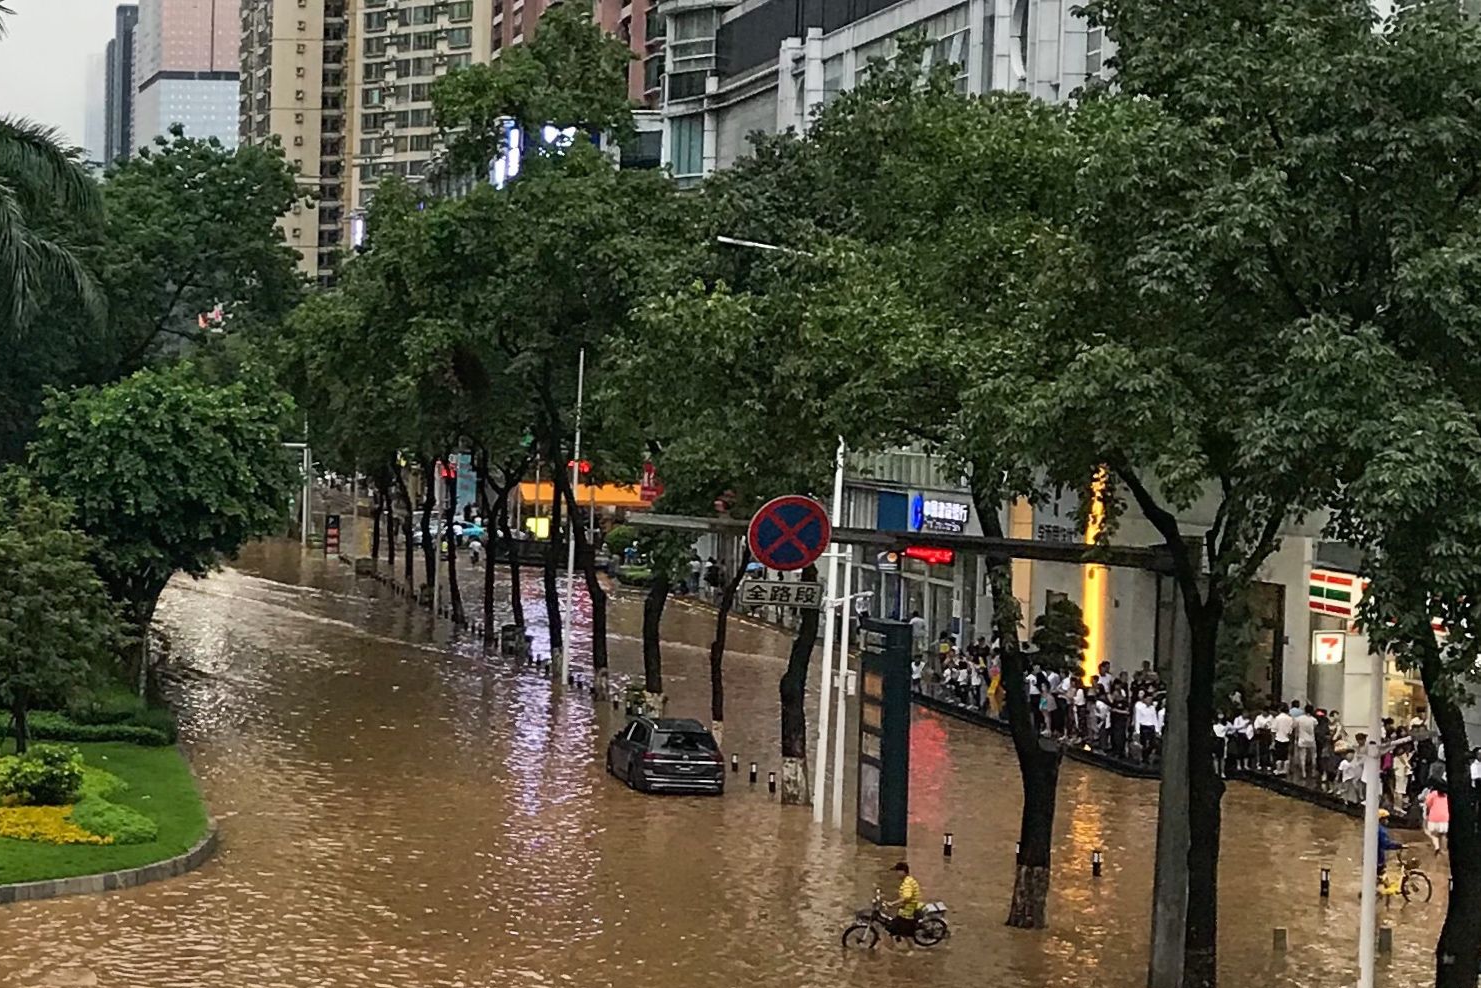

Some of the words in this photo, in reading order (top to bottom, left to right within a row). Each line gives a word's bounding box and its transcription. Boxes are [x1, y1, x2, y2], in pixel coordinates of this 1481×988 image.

[746, 585, 816, 603] 全路段
[1321, 637, 1339, 660] 7
